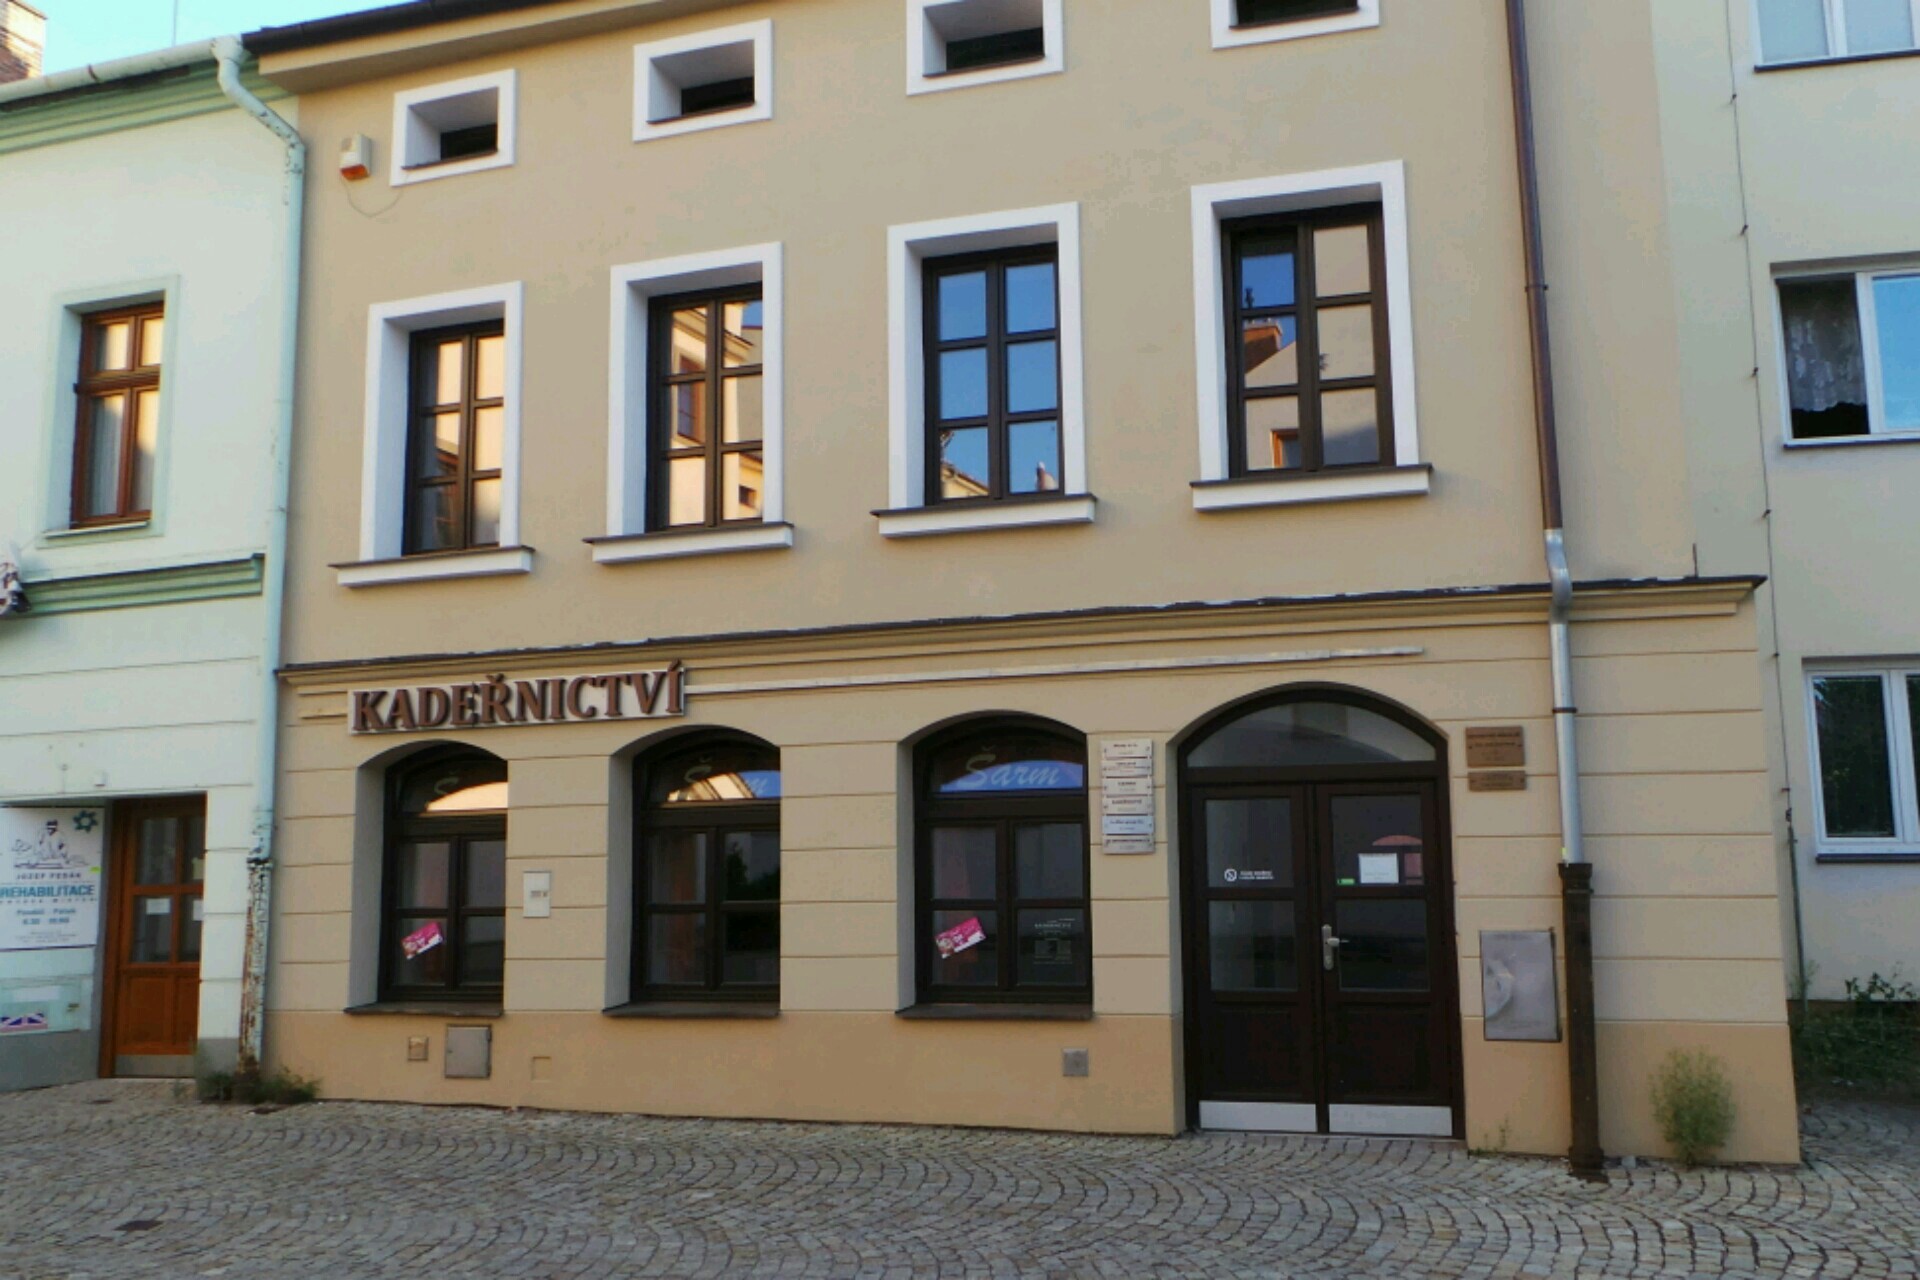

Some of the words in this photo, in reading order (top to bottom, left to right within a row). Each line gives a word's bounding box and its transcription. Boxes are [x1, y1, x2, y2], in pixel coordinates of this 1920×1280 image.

[352, 659, 683, 731] KADEŘNICTVÍ
[957, 744, 1060, 788] Šarm
[0, 884, 96, 898] REHABILITACE
